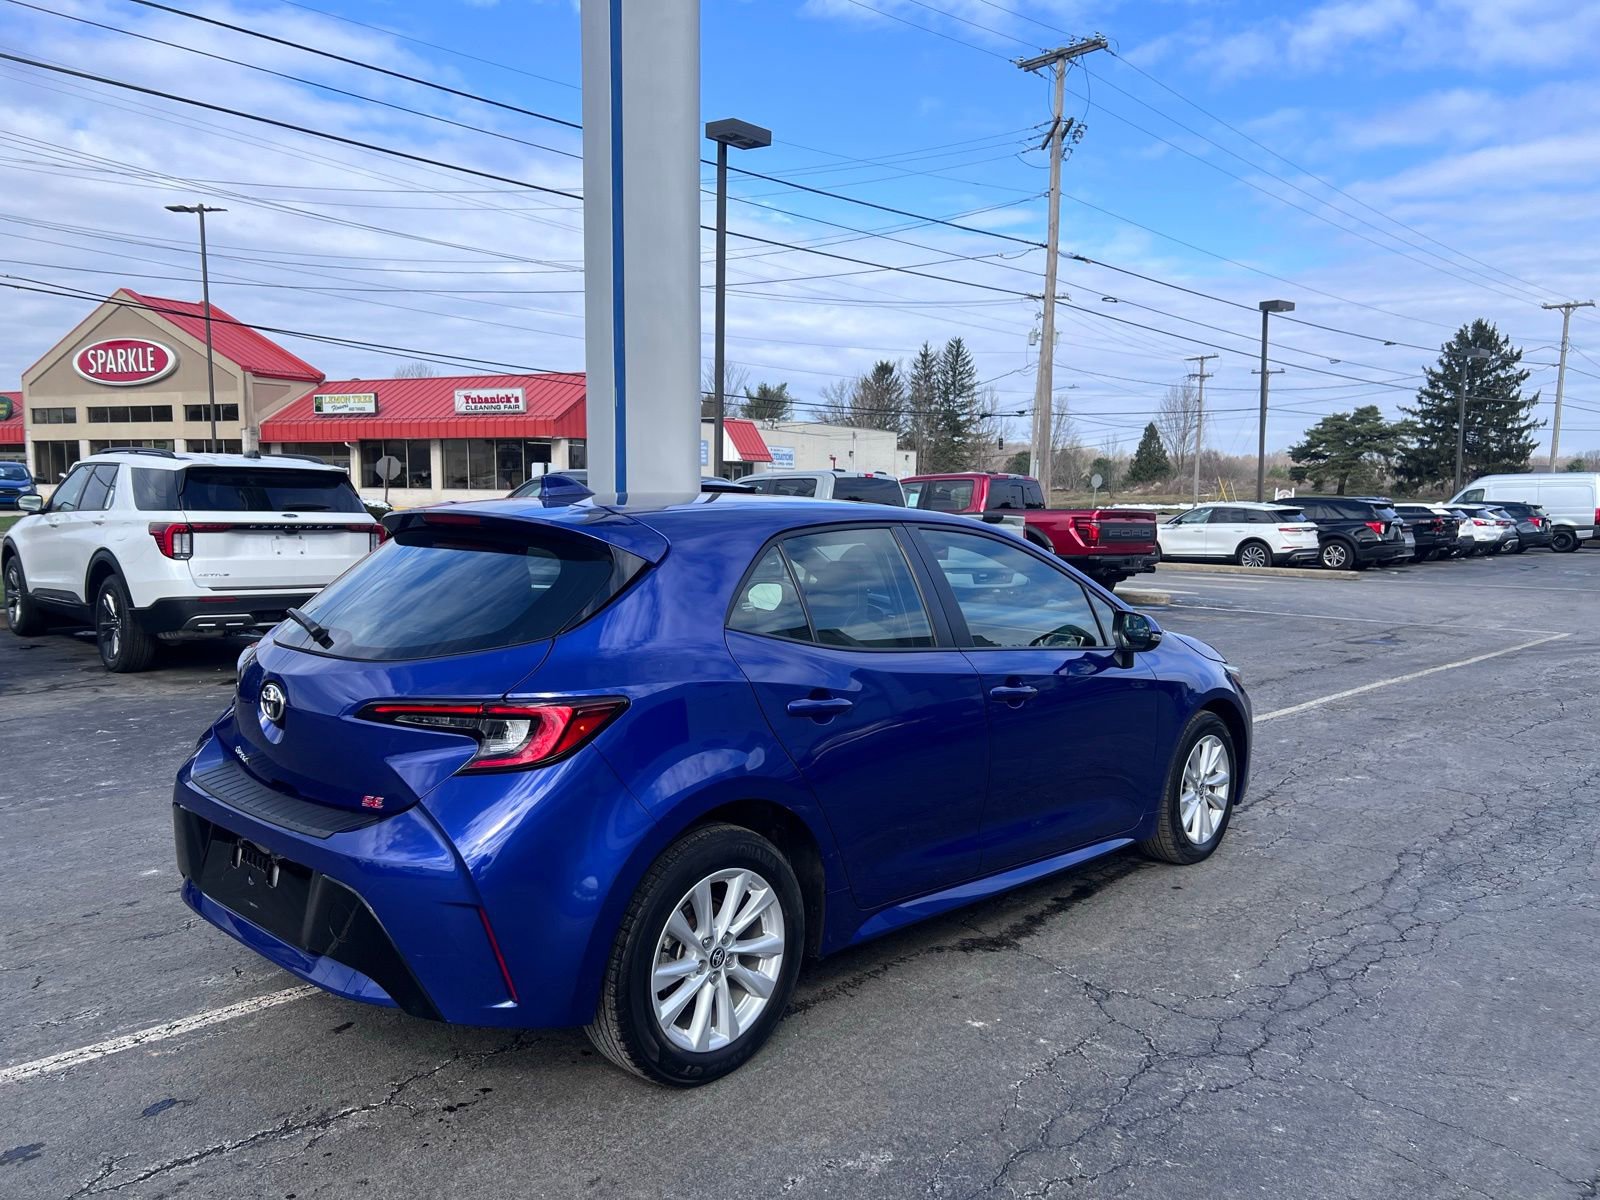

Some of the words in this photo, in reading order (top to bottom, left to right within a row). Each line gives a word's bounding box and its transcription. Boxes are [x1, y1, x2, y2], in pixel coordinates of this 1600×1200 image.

[87, 347, 156, 374] SPARKLE
[323, 395, 351, 405] LEMON
[351, 394, 373, 404] TREE
[1109, 528, 1151, 537] FORD
[361, 795, 385, 809] SE
